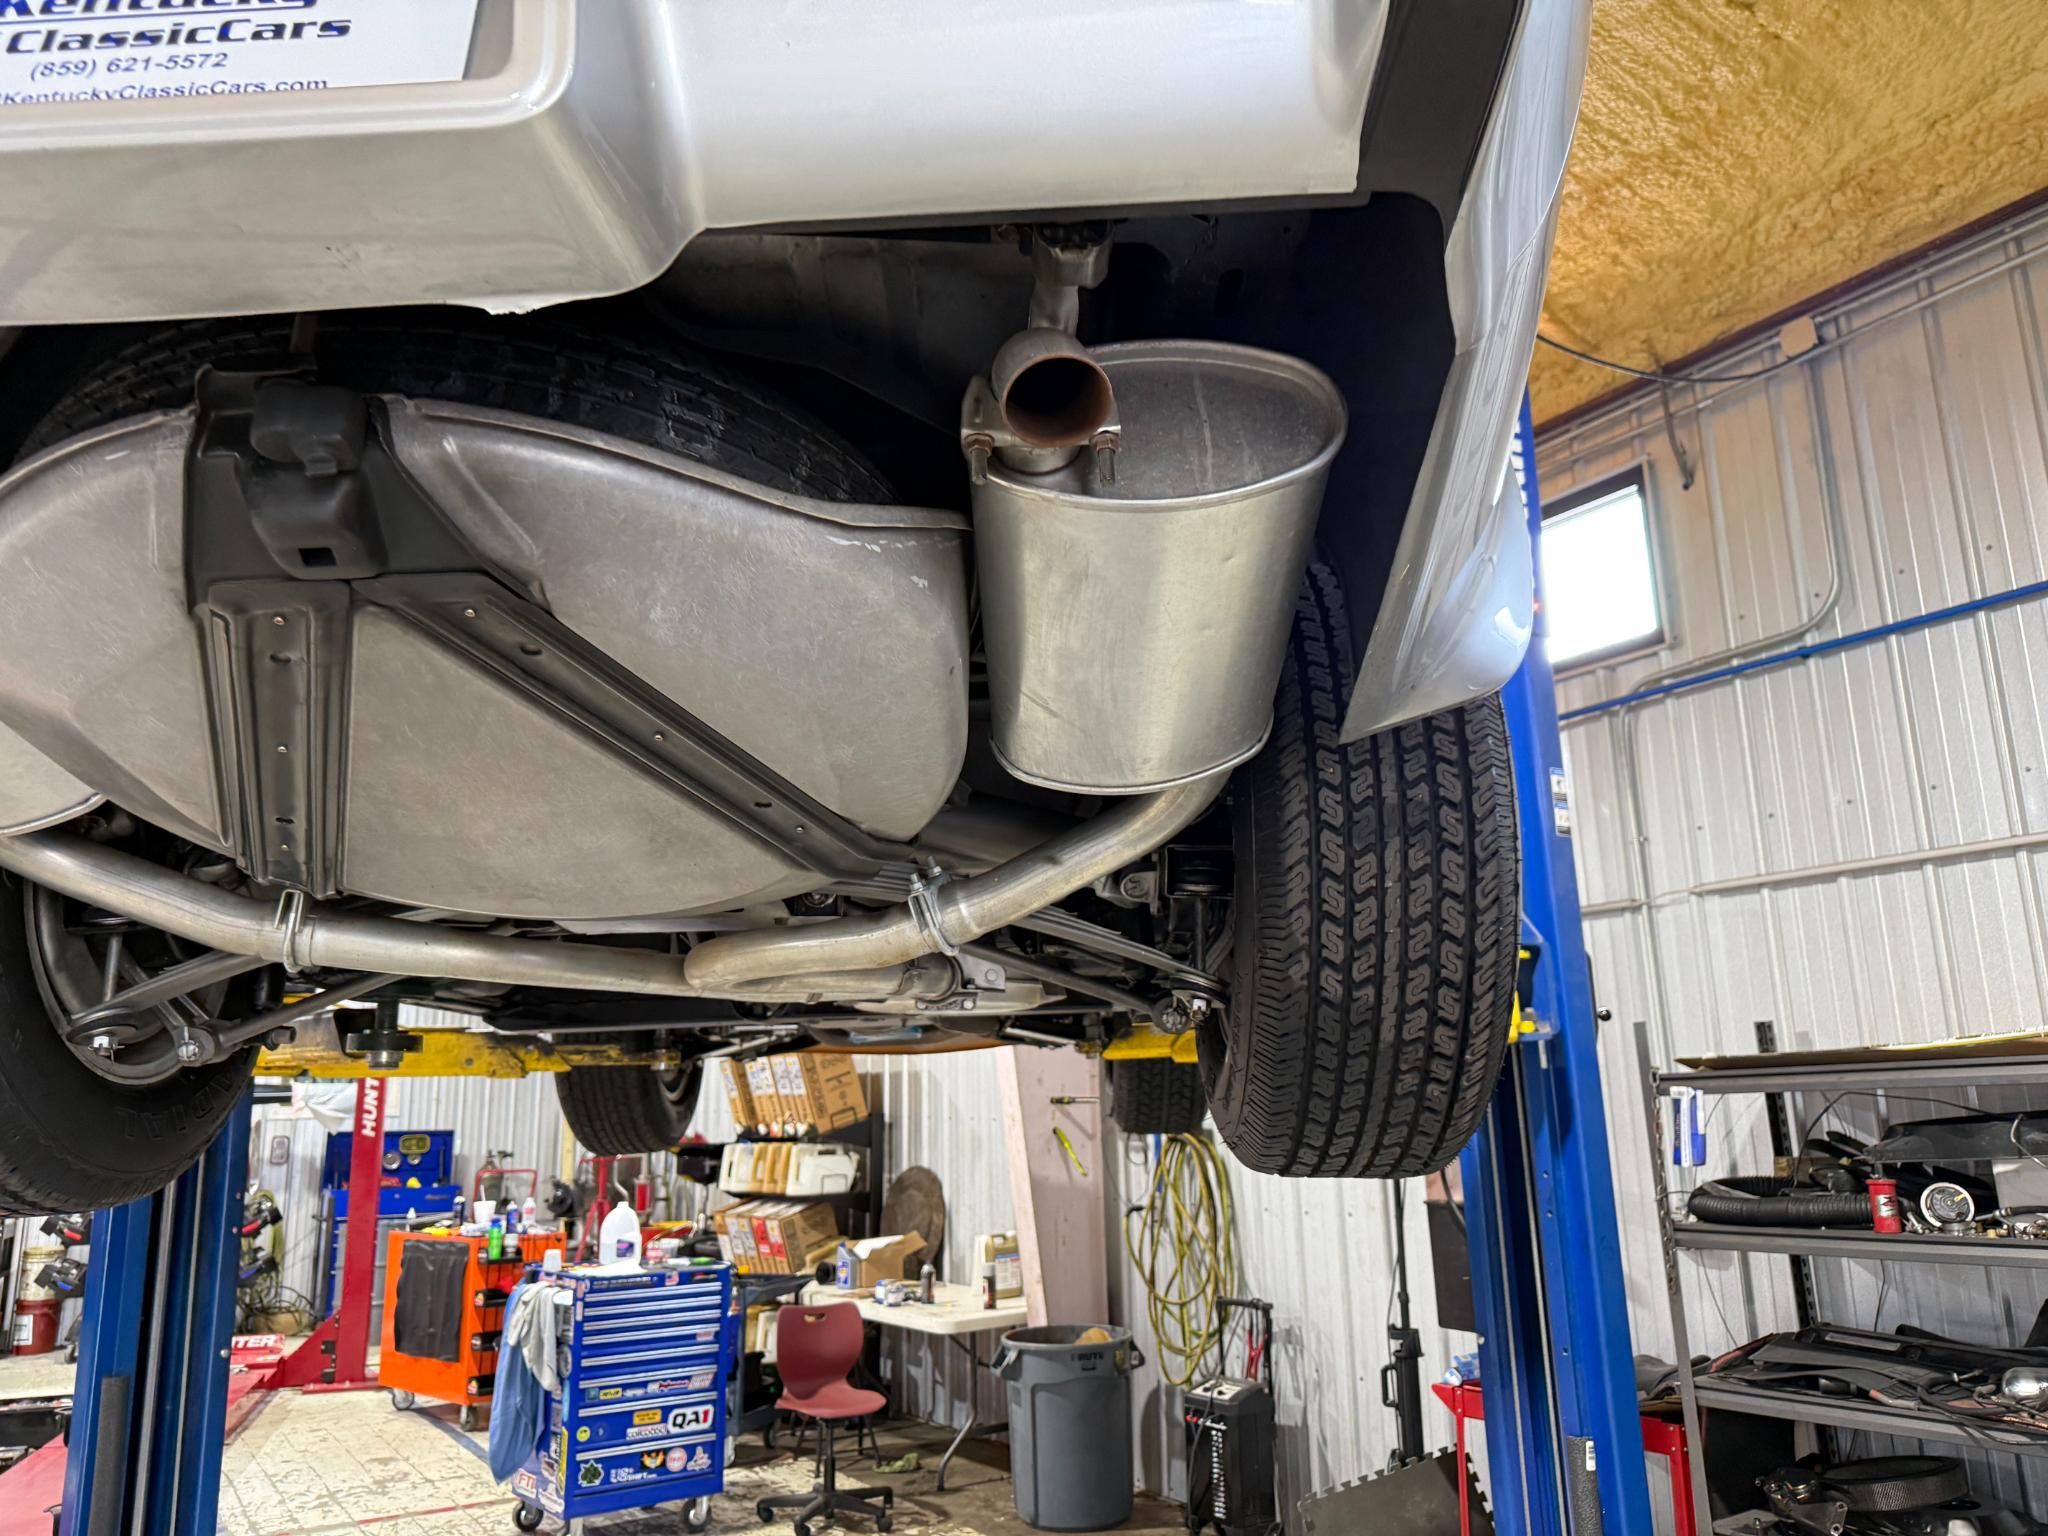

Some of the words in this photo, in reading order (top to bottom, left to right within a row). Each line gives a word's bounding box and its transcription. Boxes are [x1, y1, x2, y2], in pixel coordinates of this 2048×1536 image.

[6, 19, 352, 54] ClassicCars
[31, 59, 97, 81] (859)
[107, 53, 228, 73] 621-5572
[0, 79, 328, 104] KentuckyClassicCars.com
[672, 1409, 710, 1429] QA1
